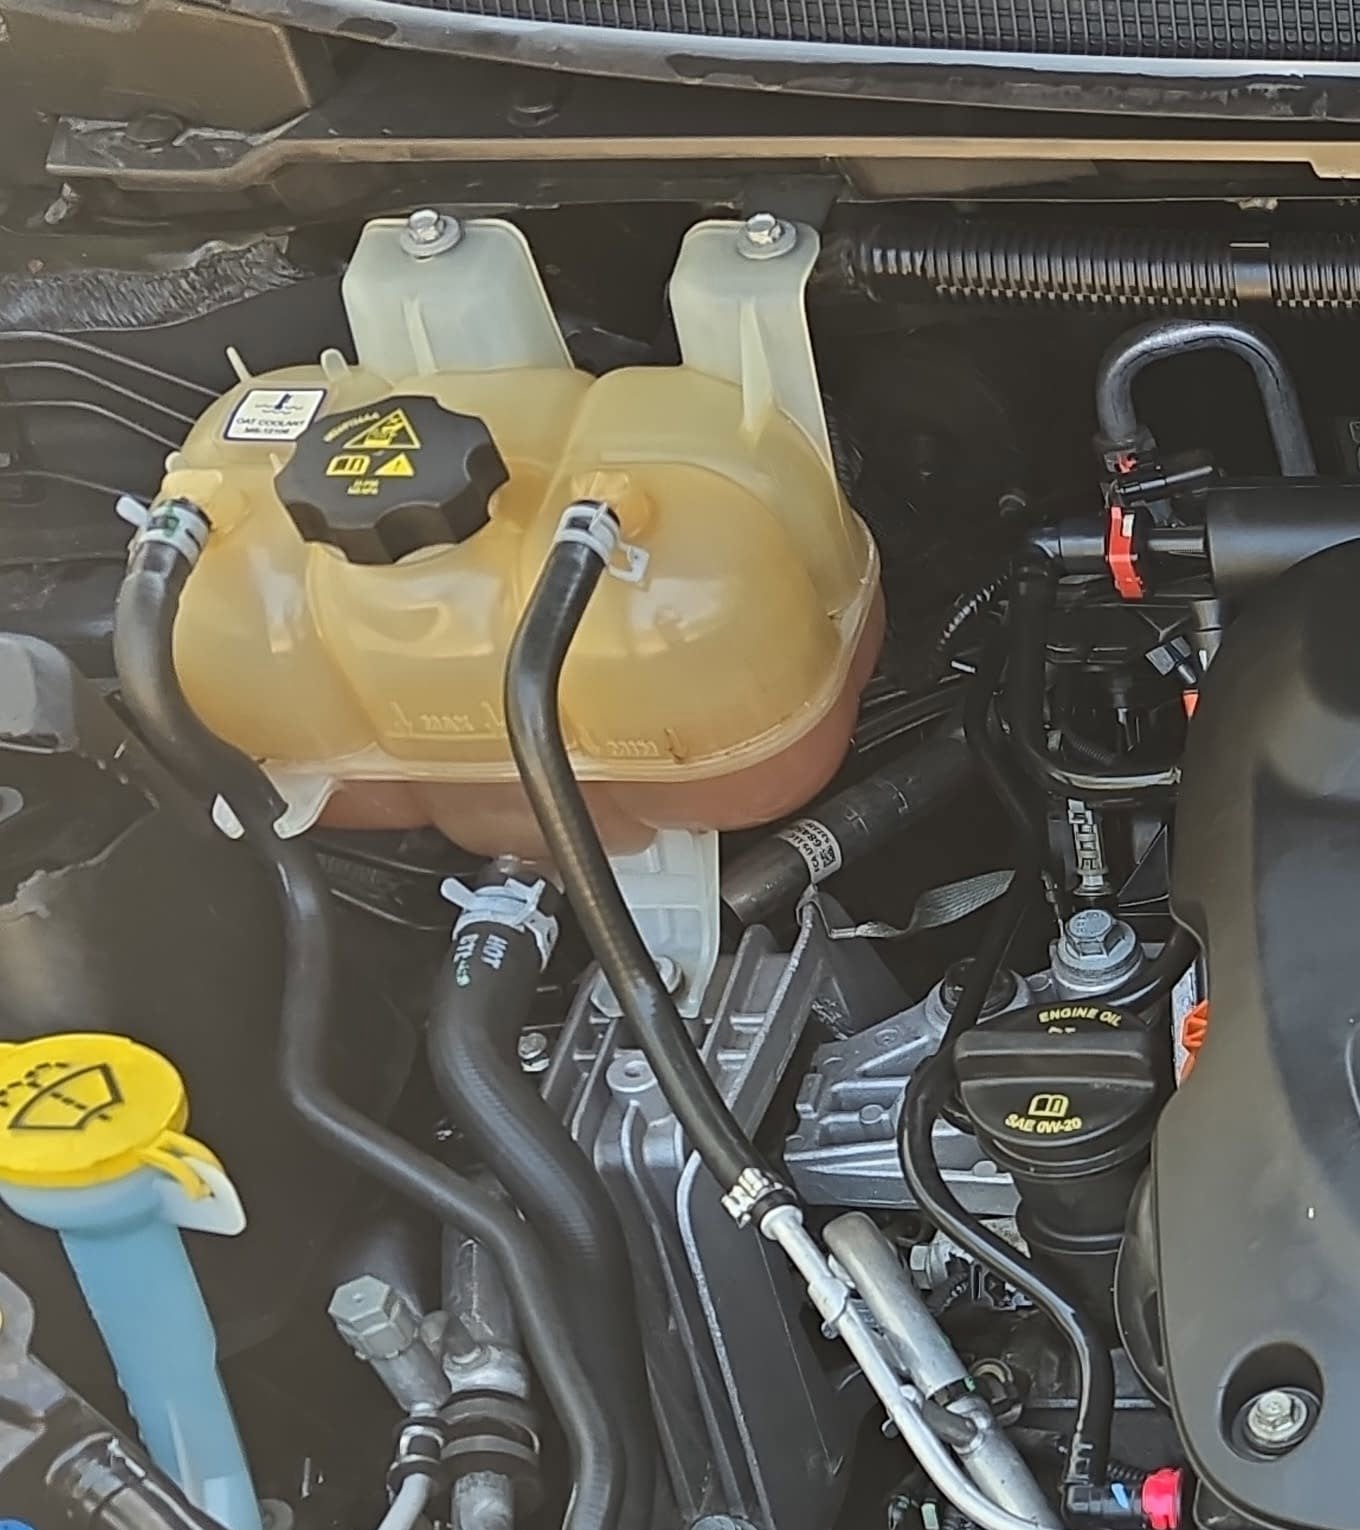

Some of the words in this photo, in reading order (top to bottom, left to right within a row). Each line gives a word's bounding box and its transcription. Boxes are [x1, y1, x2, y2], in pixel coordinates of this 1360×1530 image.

[1038, 1007, 1099, 1023] ENGINE
[1099, 1011, 1122, 1027] OIL
[1004, 1114, 1035, 1132] SAE
